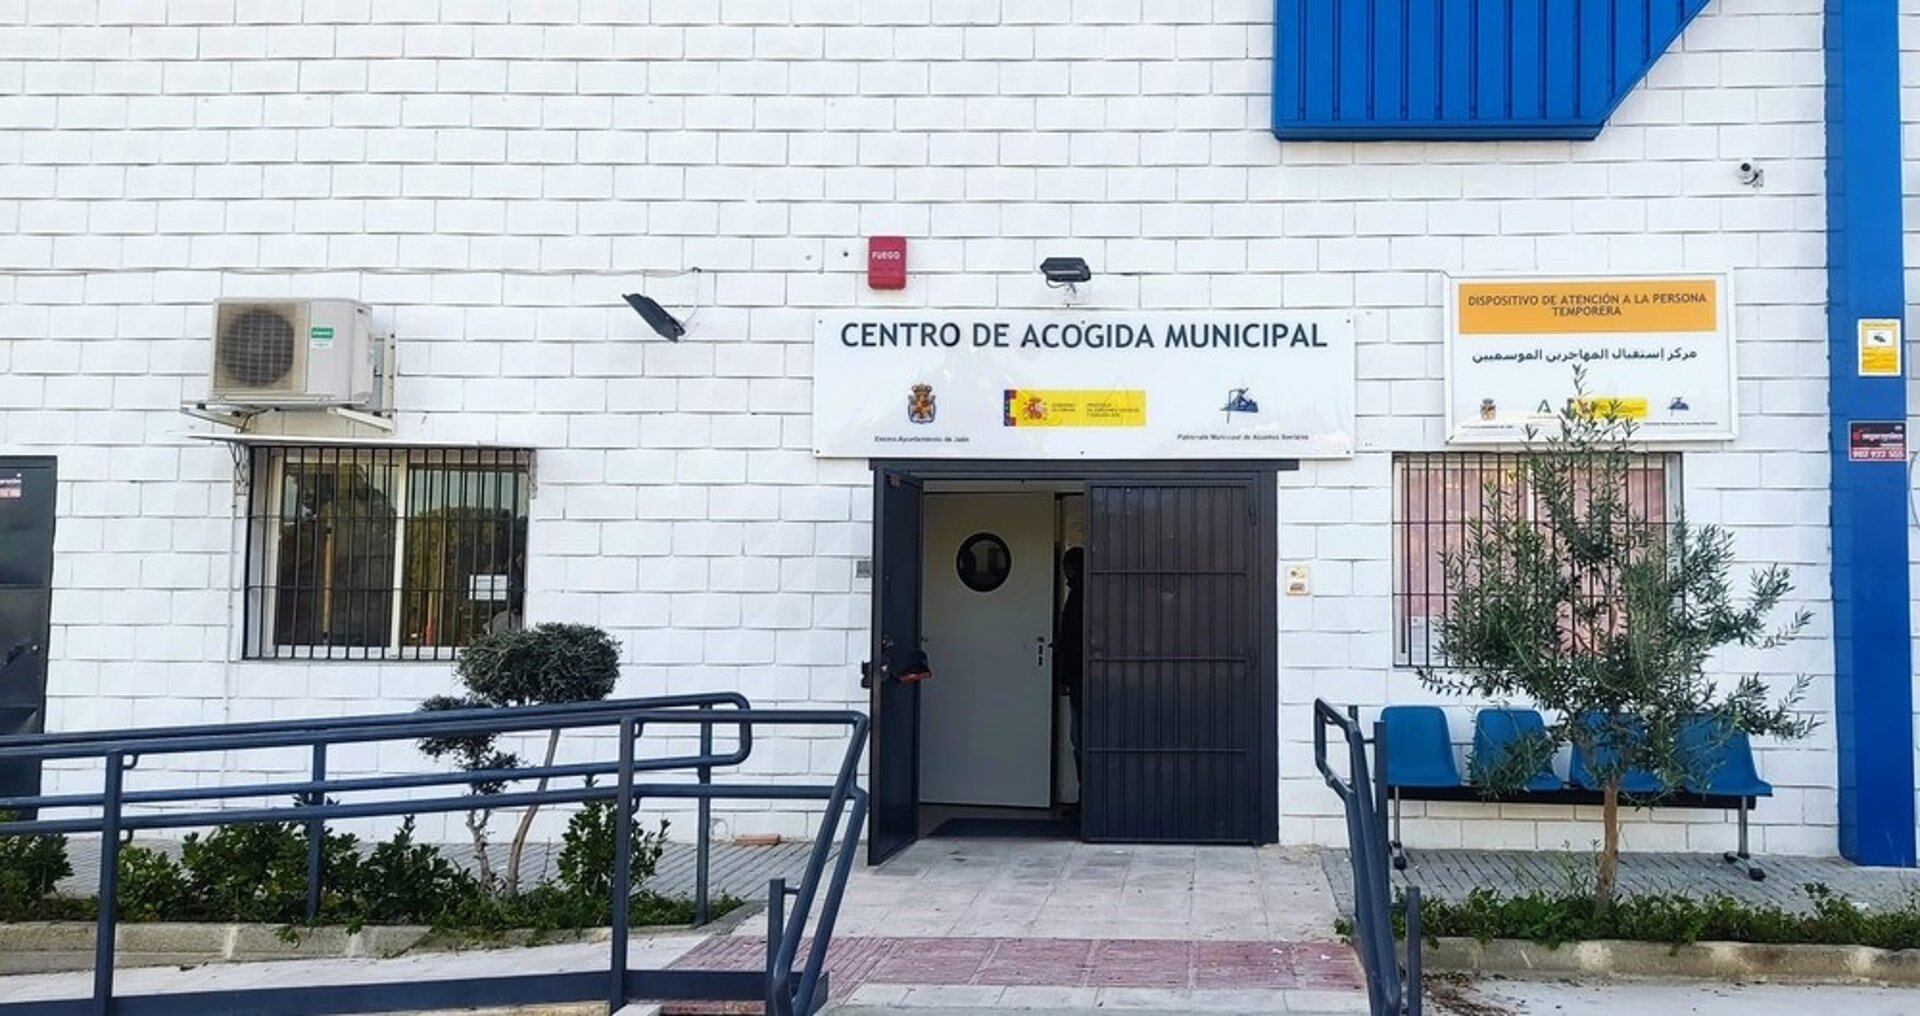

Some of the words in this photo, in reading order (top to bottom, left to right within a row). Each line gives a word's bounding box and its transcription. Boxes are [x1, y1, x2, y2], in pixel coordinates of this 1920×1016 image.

[871, 251, 901, 260] FUEGO
[1468, 295, 1538, 306] DISPOSITIVO
[1541, 295, 1557, 305] DE
[1560, 293, 1620, 305] ATENCIÓN
[1623, 294, 1632, 304] A
[1634, 294, 1650, 304] LA
[1652, 292, 1707, 304] PERSONA
[1551, 305, 1623, 317] TEMPORERA
[840, 323, 961, 348] CENTRO
[972, 323, 1010, 348] DE
[1020, 323, 1155, 348] ACOGIDA
[1164, 323, 1328, 348] MUNICIPAL
[1667, 347, 1697, 361] مركز
